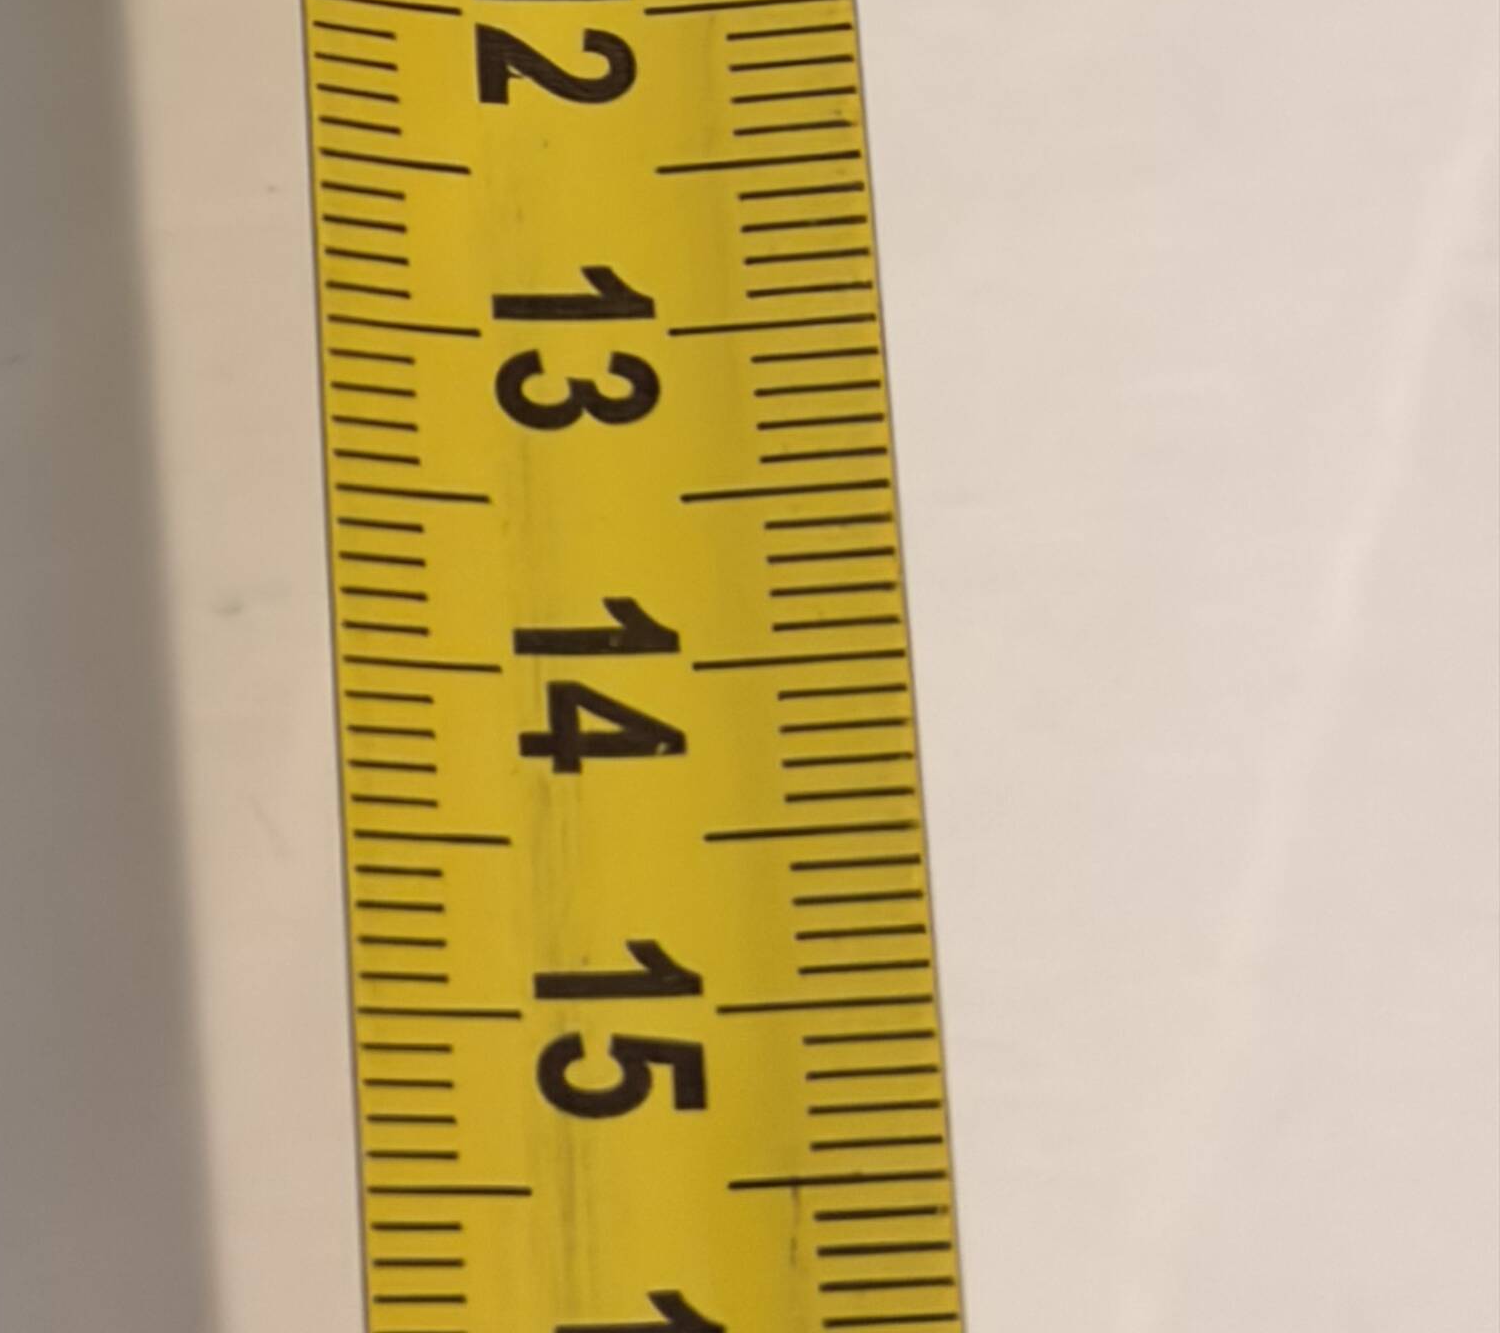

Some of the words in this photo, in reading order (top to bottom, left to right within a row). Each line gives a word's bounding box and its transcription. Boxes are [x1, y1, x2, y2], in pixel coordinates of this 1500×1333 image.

[492, 266, 661, 431] 13
[513, 597, 687, 775] 14
[533, 940, 707, 1120] 15
[554, 1289, 728, 1333] 1
